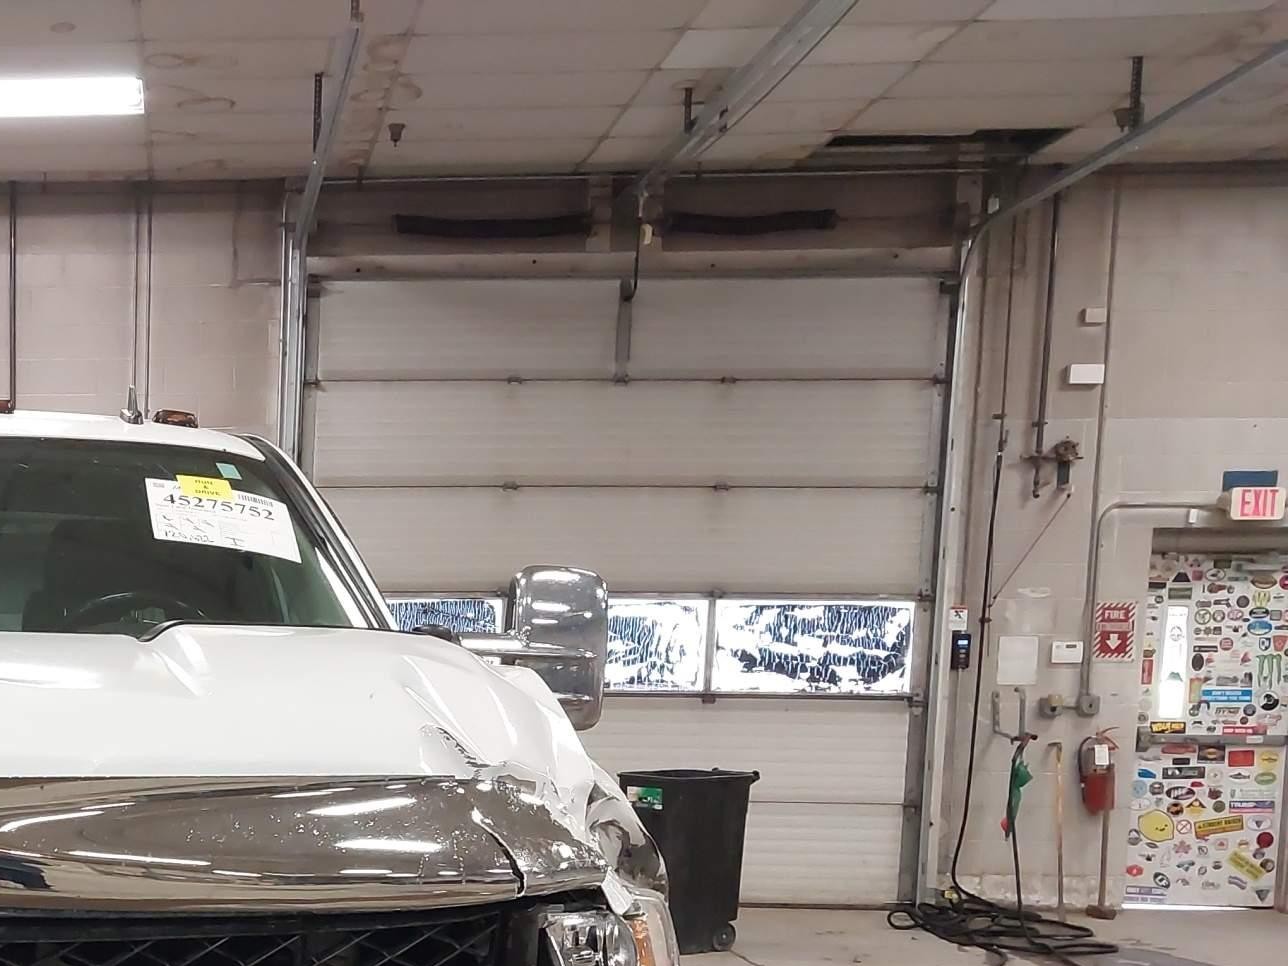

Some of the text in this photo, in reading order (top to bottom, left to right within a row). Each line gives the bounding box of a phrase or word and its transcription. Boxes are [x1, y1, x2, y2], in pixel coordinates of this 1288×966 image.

[163, 493, 275, 521] 45275752
[1240, 489, 1279, 517] EXIT
[1104, 610, 1127, 620] FIRE
[1230, 801, 1257, 809] TRUMP
